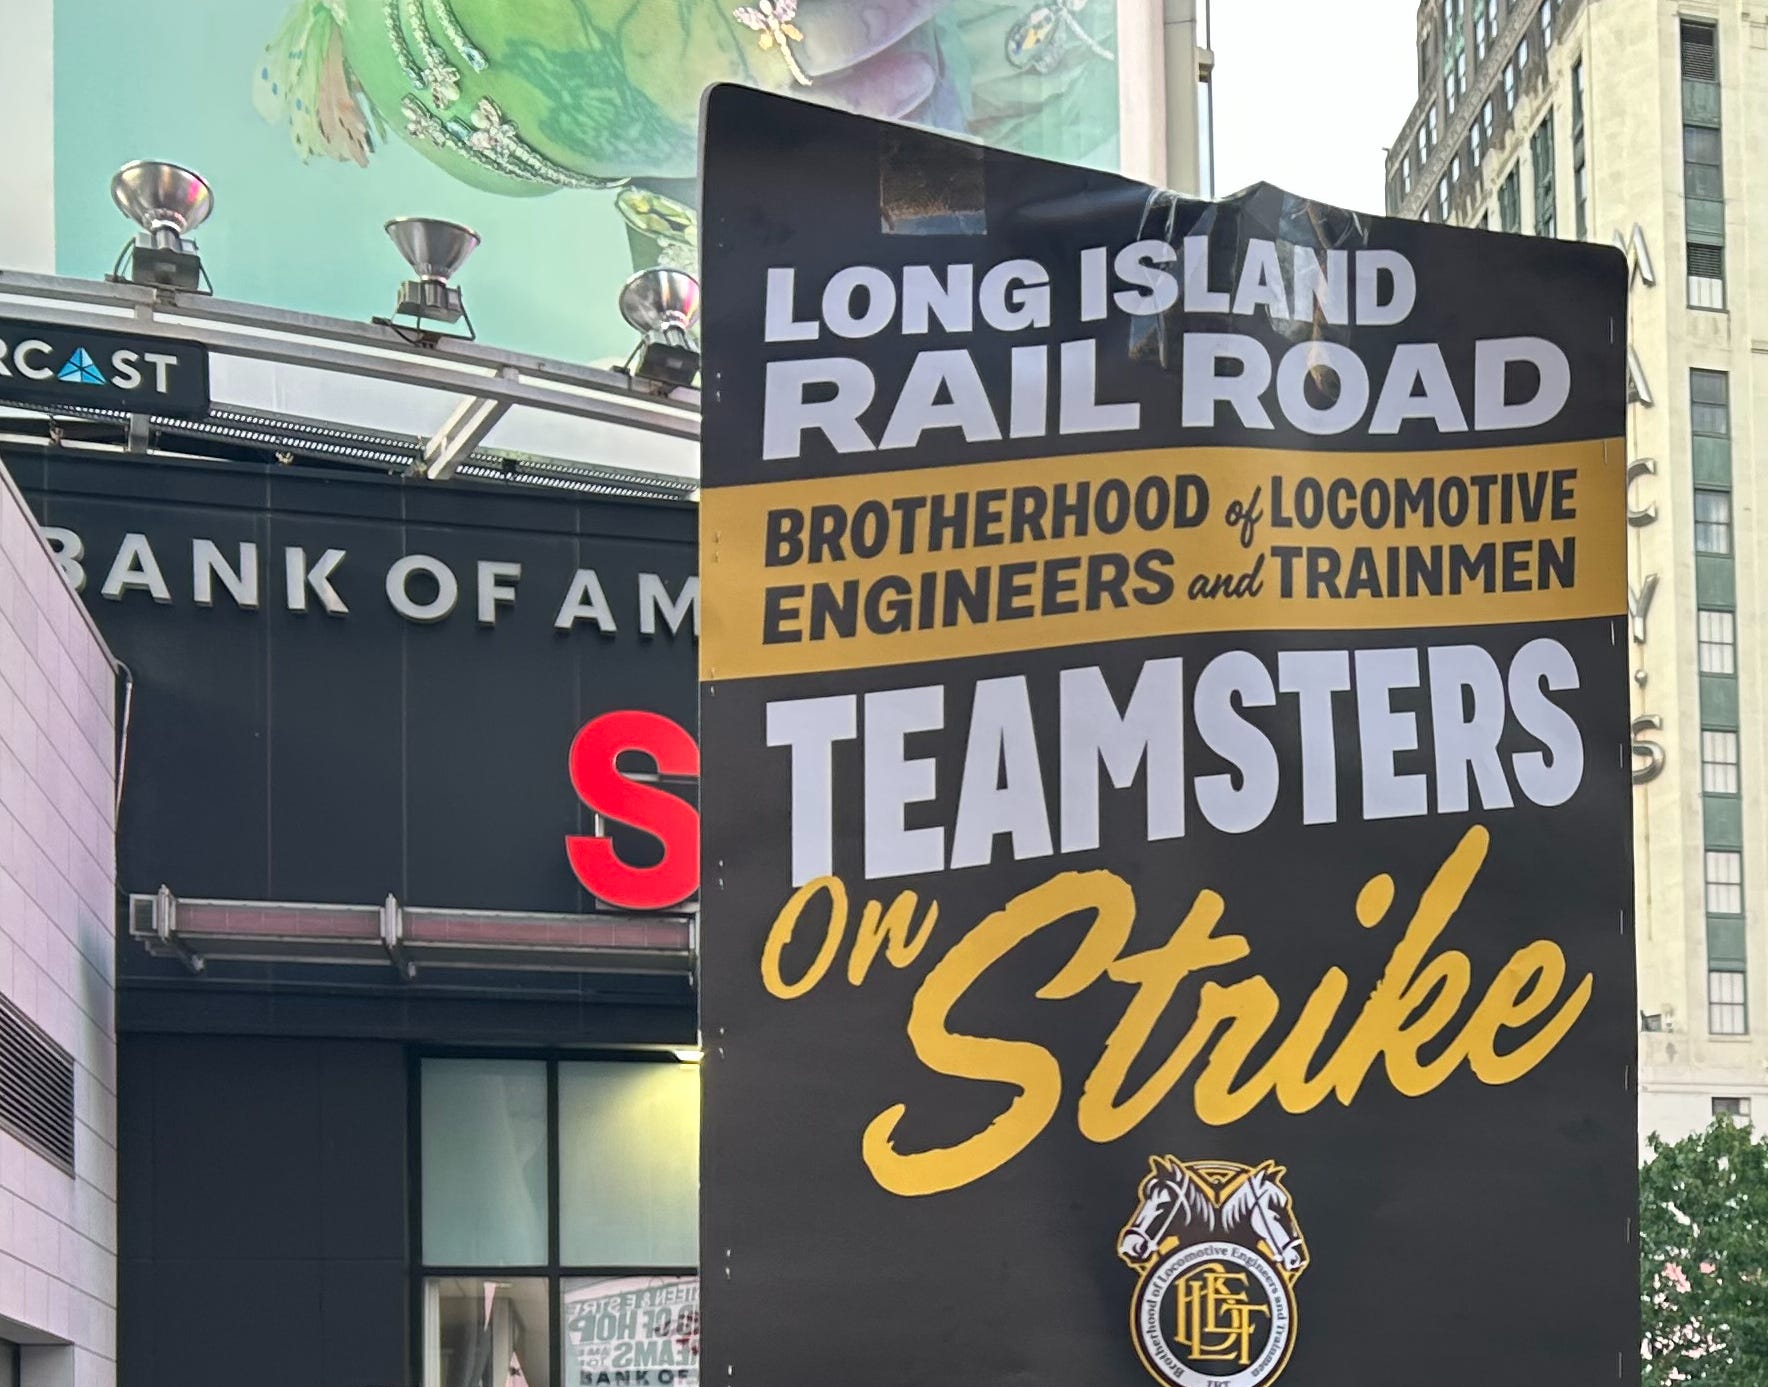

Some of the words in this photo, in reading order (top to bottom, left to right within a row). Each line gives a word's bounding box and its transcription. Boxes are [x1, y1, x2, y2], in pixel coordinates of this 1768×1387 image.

[764, 258, 1051, 344] LONG
[1080, 233, 1417, 327] ISLAND
[762, 338, 1142, 461] RAIL
[1182, 332, 1573, 436] ROAD
[764, 473, 1210, 568] BROTHERHOOD
[1224, 486, 1264, 550] of
[1270, 468, 1578, 531] LOCOMOTIVE
[41, 525, 348, 615] BANK
[385, 554, 522, 627] OF
[762, 549, 1176, 644] ENGINEERS
[1188, 555, 1266, 601] and
[1270, 537, 1578, 600] TRAINMEN
[766, 637, 1584, 888] TEAMSTERS
[760, 875, 938, 999] On
[861, 824, 1594, 1197] Strike
[1153, 1279, 1165, 1295] of
[1161, 1245, 1229, 1286] Locomotive
[1230, 1245, 1278, 1294] Engineers
[1274, 1294, 1287, 1321] and
[1146, 1299, 1185, 1379] Brotherhood
[1251, 1322, 1287, 1377] Trainmen
